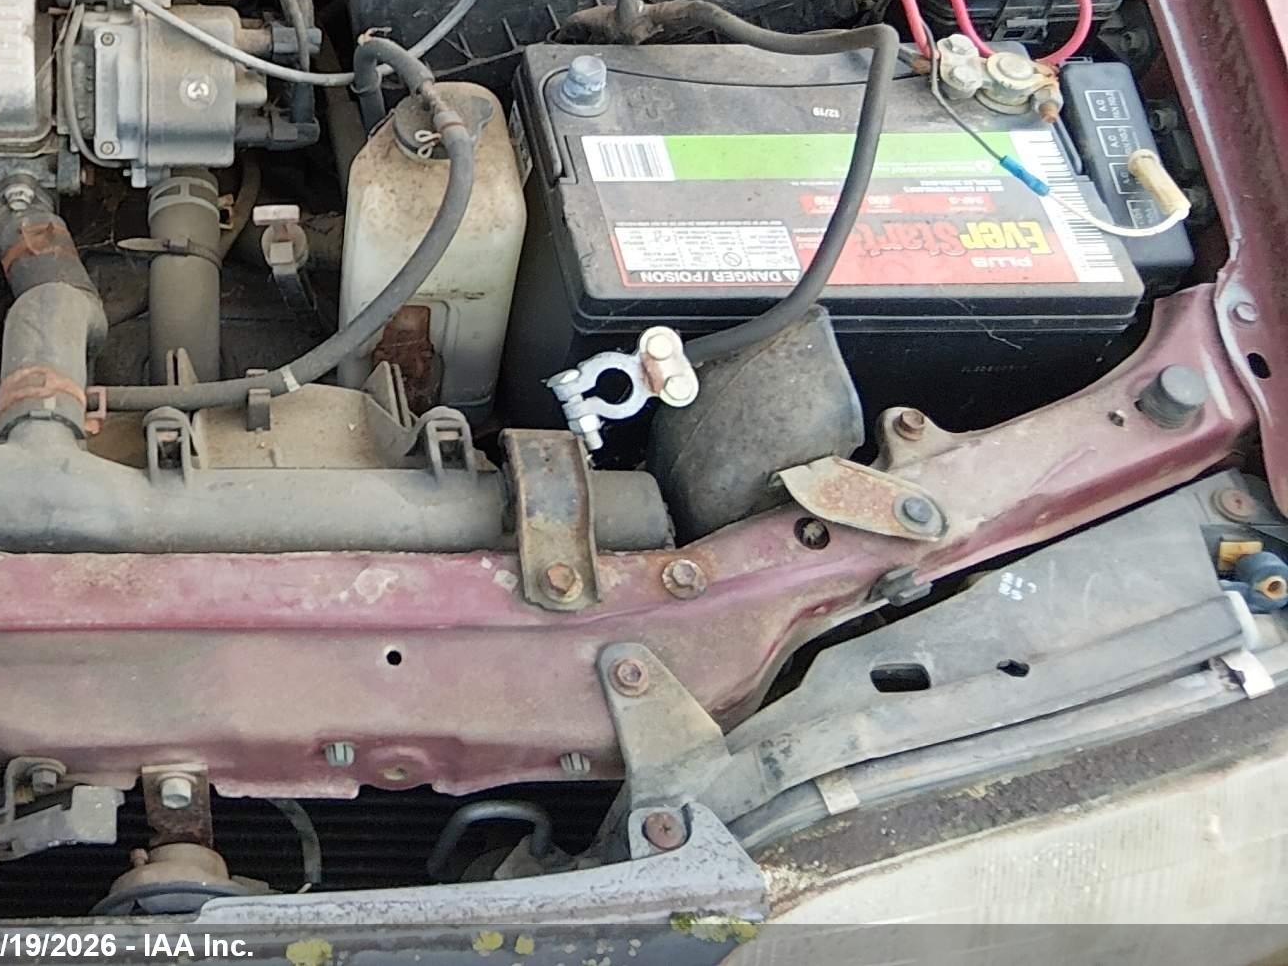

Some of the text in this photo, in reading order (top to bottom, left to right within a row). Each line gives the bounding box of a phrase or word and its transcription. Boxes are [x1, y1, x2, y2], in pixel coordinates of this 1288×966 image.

[969, 255, 1035, 269] PLUS
[638, 270, 702, 283] POISON
[711, 270, 783, 283] DANGER
